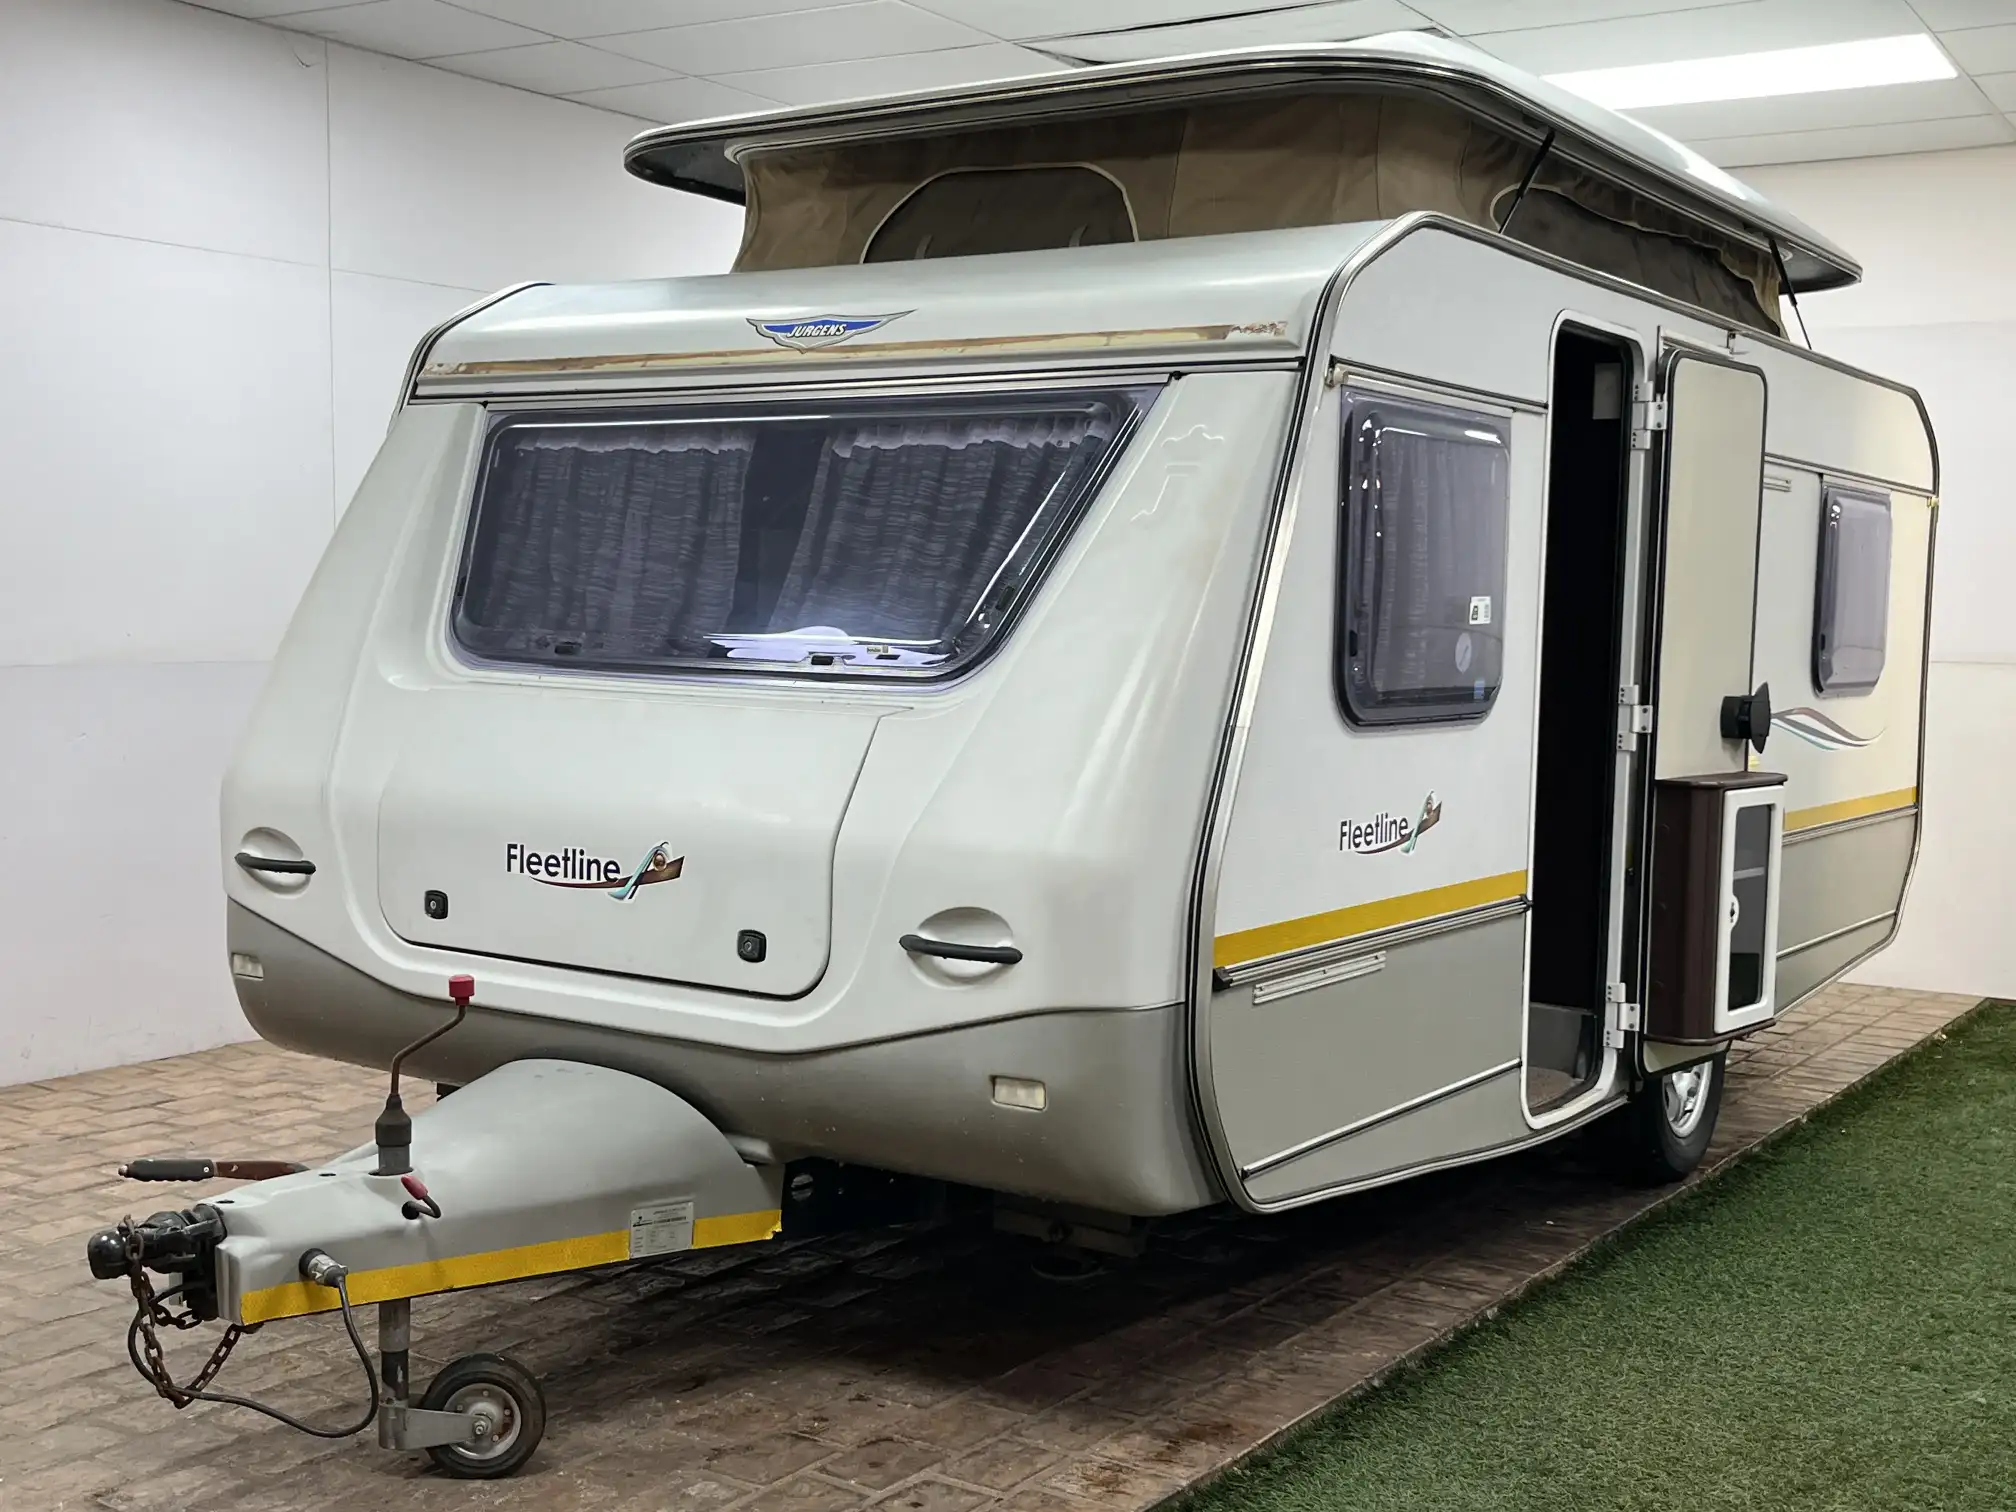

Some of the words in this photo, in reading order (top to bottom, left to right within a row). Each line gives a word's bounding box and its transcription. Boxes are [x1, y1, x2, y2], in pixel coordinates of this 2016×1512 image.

[786, 324, 847, 338] JURGENS
[1339, 812, 1409, 851] Fleetline
[506, 843, 621, 883] Fleetline
